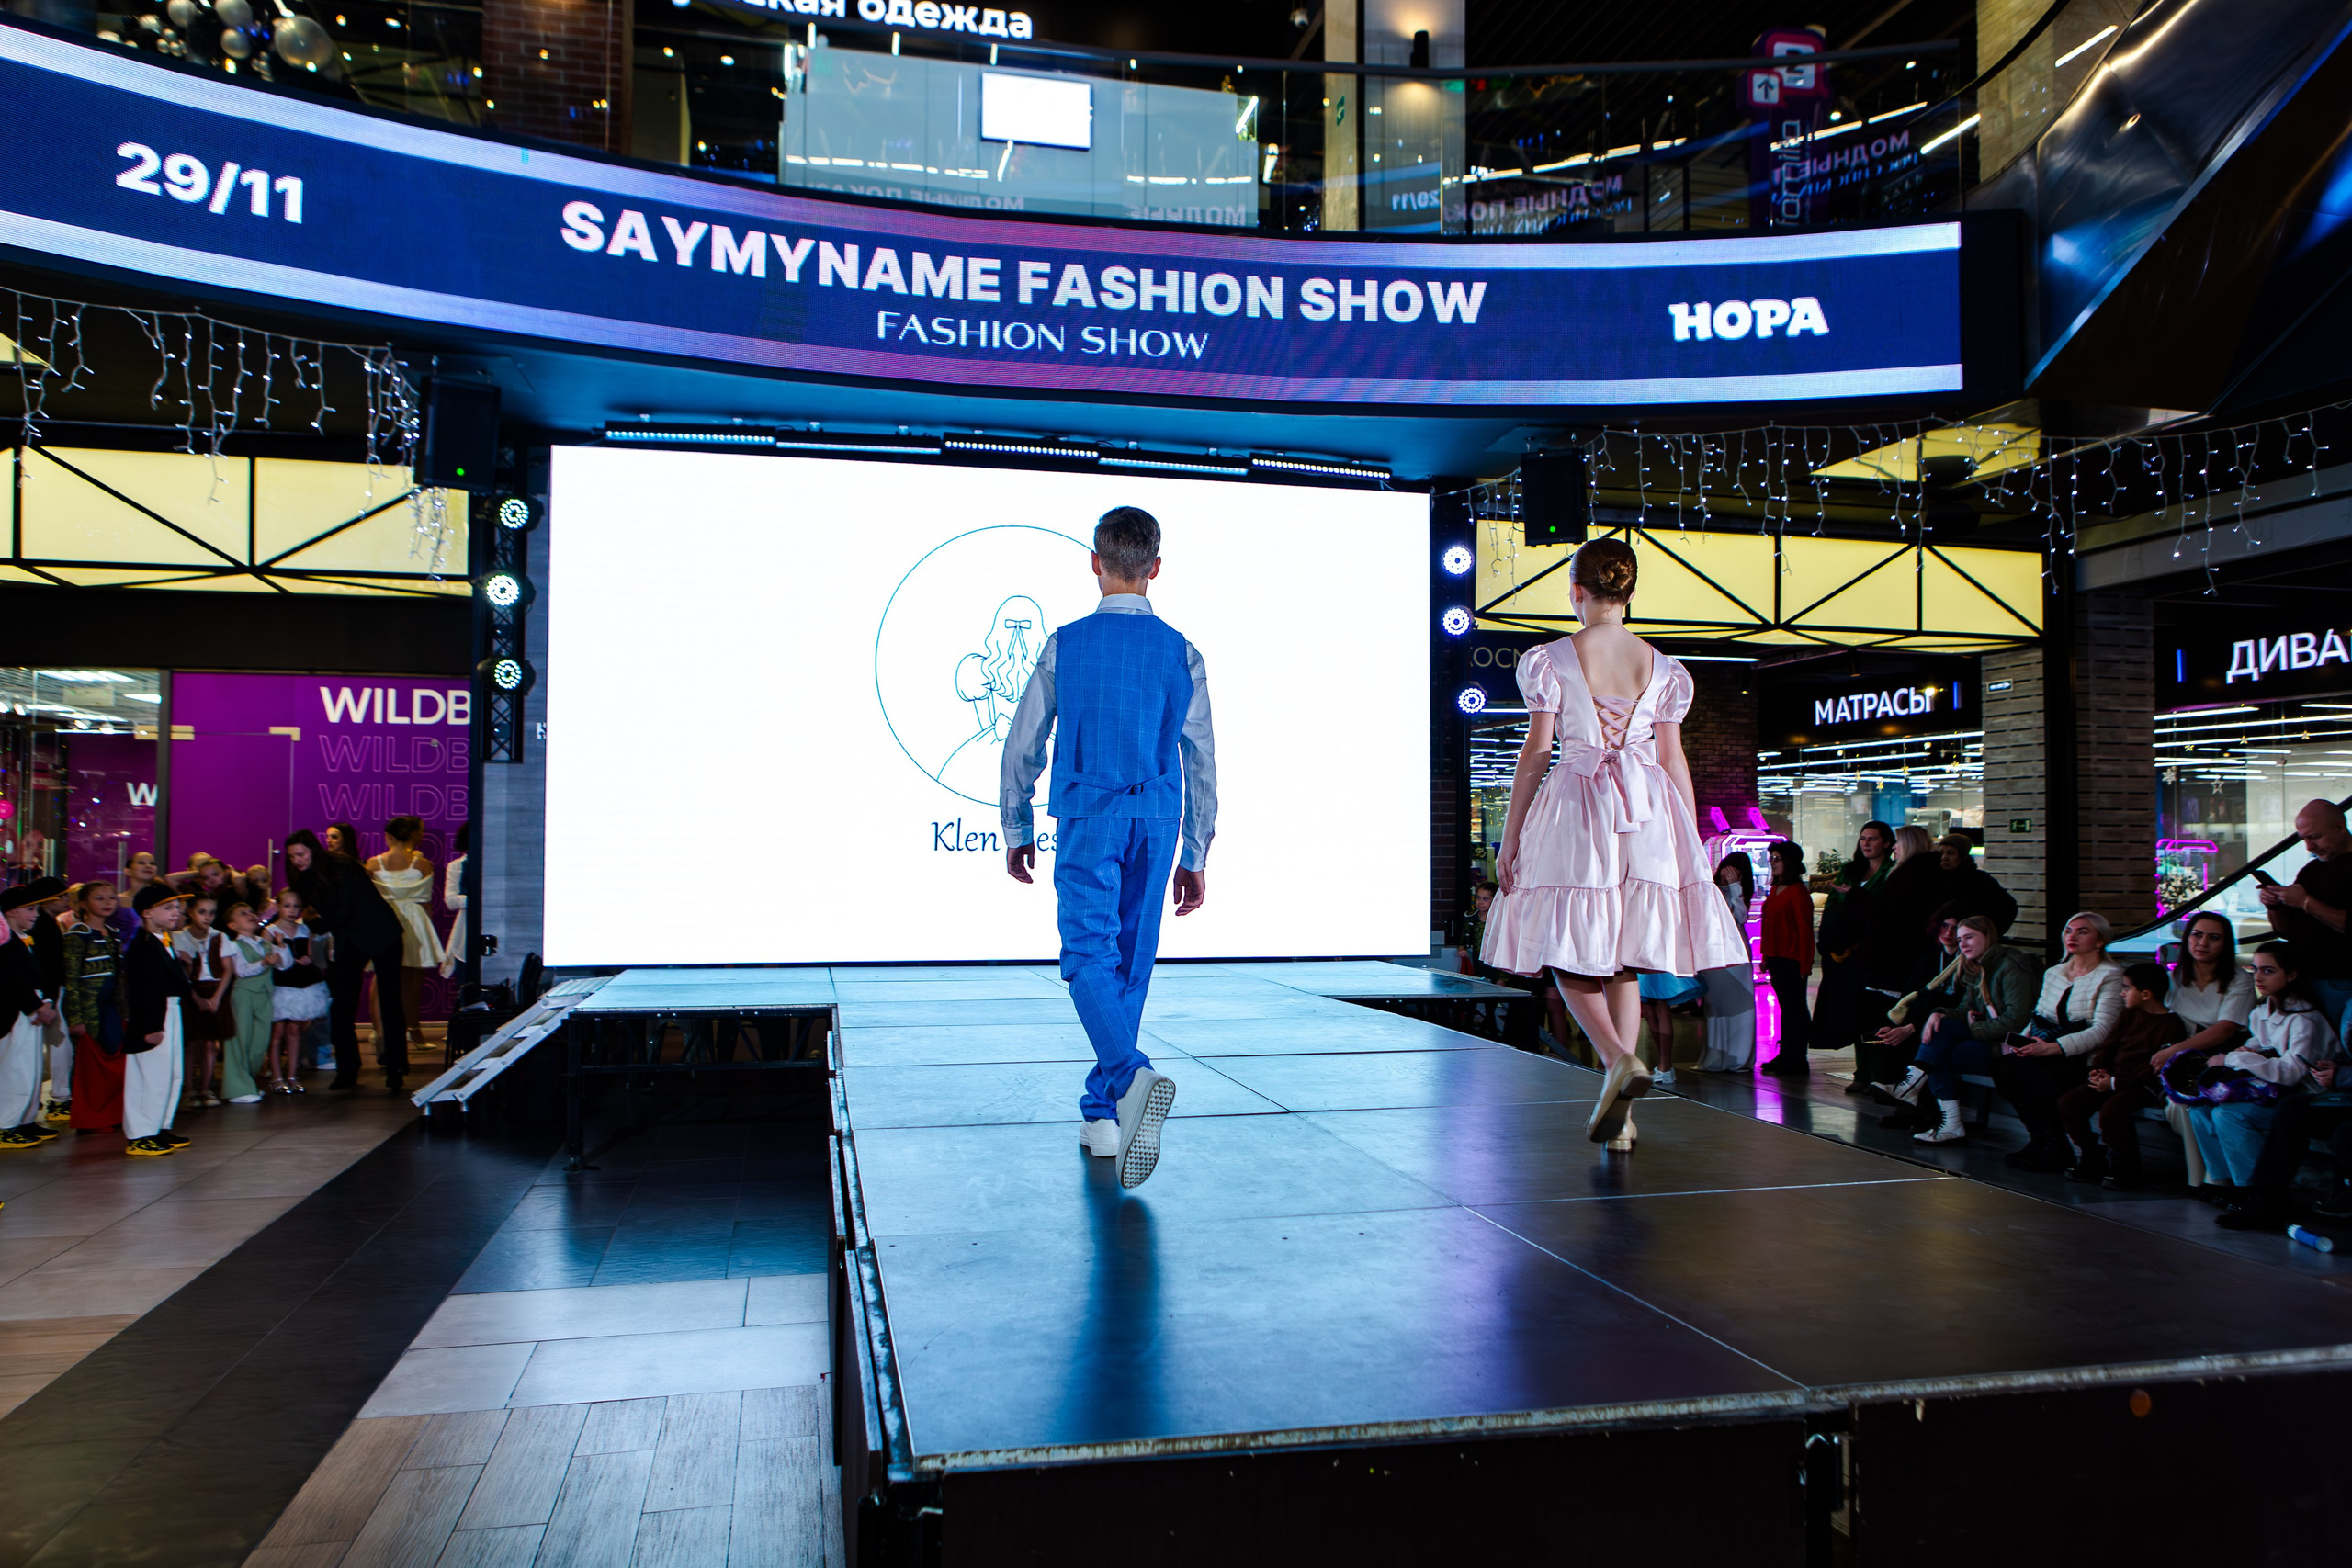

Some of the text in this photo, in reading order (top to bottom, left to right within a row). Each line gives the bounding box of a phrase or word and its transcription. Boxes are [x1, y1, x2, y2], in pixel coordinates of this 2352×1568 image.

[857, 0, 1033, 39] одежда
[116, 141, 304, 225] 29/11
[560, 200, 1487, 323] SAYMYNAME FASHION SHOW
[877, 310, 1209, 359] FASHION SHOW
[2225, 628, 2352, 684] ДИВА
[320, 686, 470, 726] WILDB
[1815, 686, 1931, 726] МАТРАСЫ
[931, 817, 1001, 852] Klen
